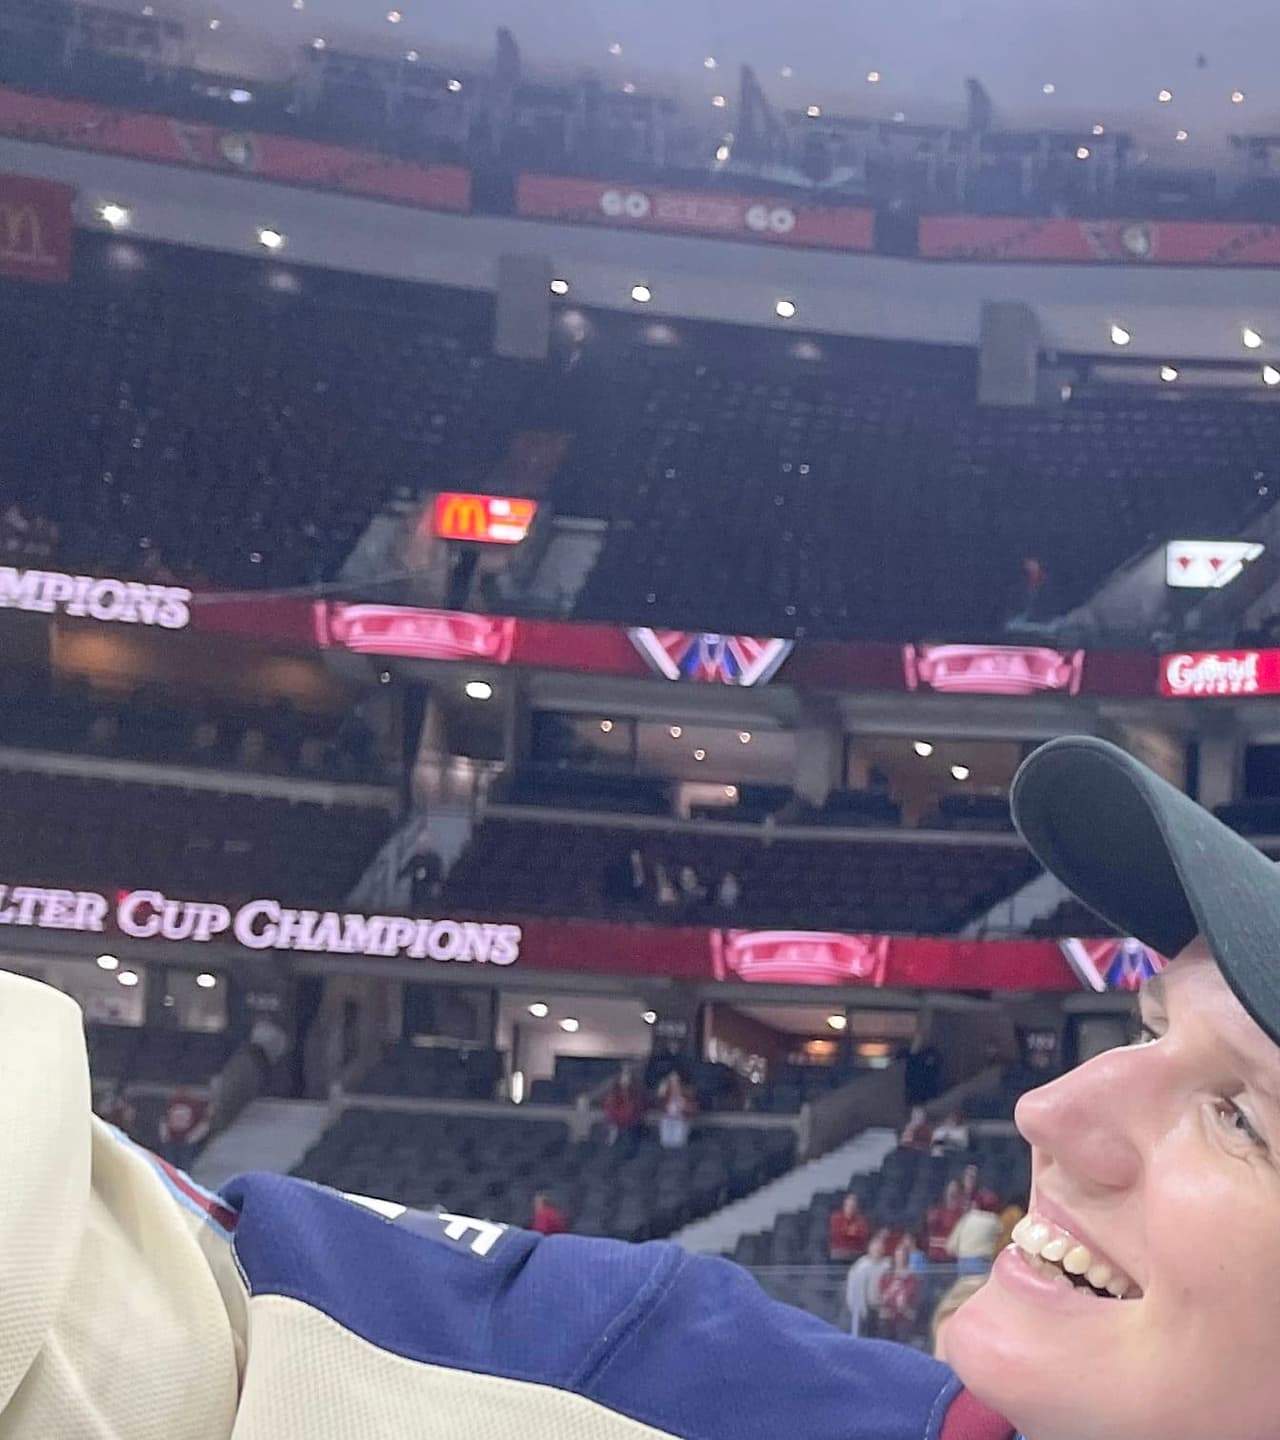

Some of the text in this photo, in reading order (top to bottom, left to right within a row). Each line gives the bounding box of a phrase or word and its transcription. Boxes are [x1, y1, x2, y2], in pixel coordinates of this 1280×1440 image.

[602, 190, 650, 218] GO
[745, 205, 796, 233] GO
[0, 566, 191, 629] MPIONS
[0, 884, 522, 966] LTER CUP CHAMPIONS
